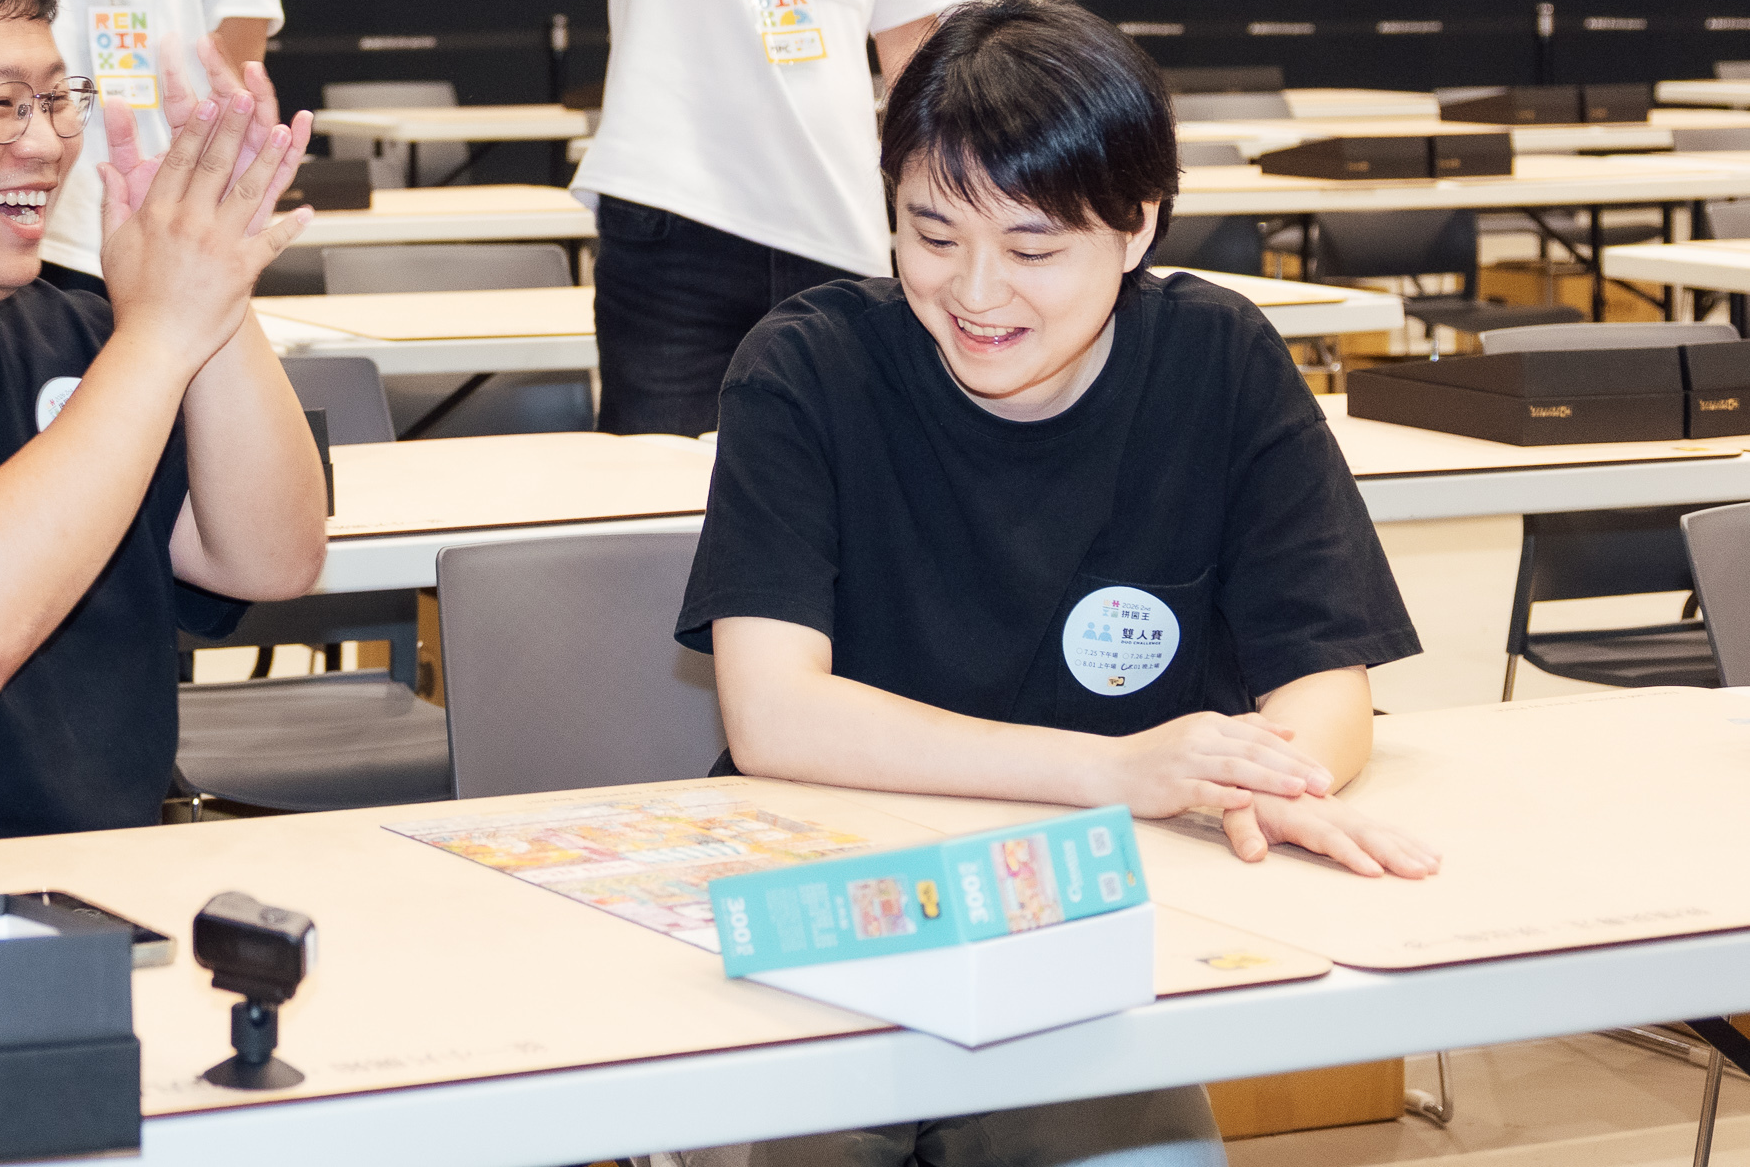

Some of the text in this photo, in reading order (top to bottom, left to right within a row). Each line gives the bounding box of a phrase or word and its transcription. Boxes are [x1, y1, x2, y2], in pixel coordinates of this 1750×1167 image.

[95, 12, 147, 30] REN
[96, 32, 148, 49] OIR
[1121, 627, 1163, 641] 雙人賽
[726, 896, 752, 944] 300
